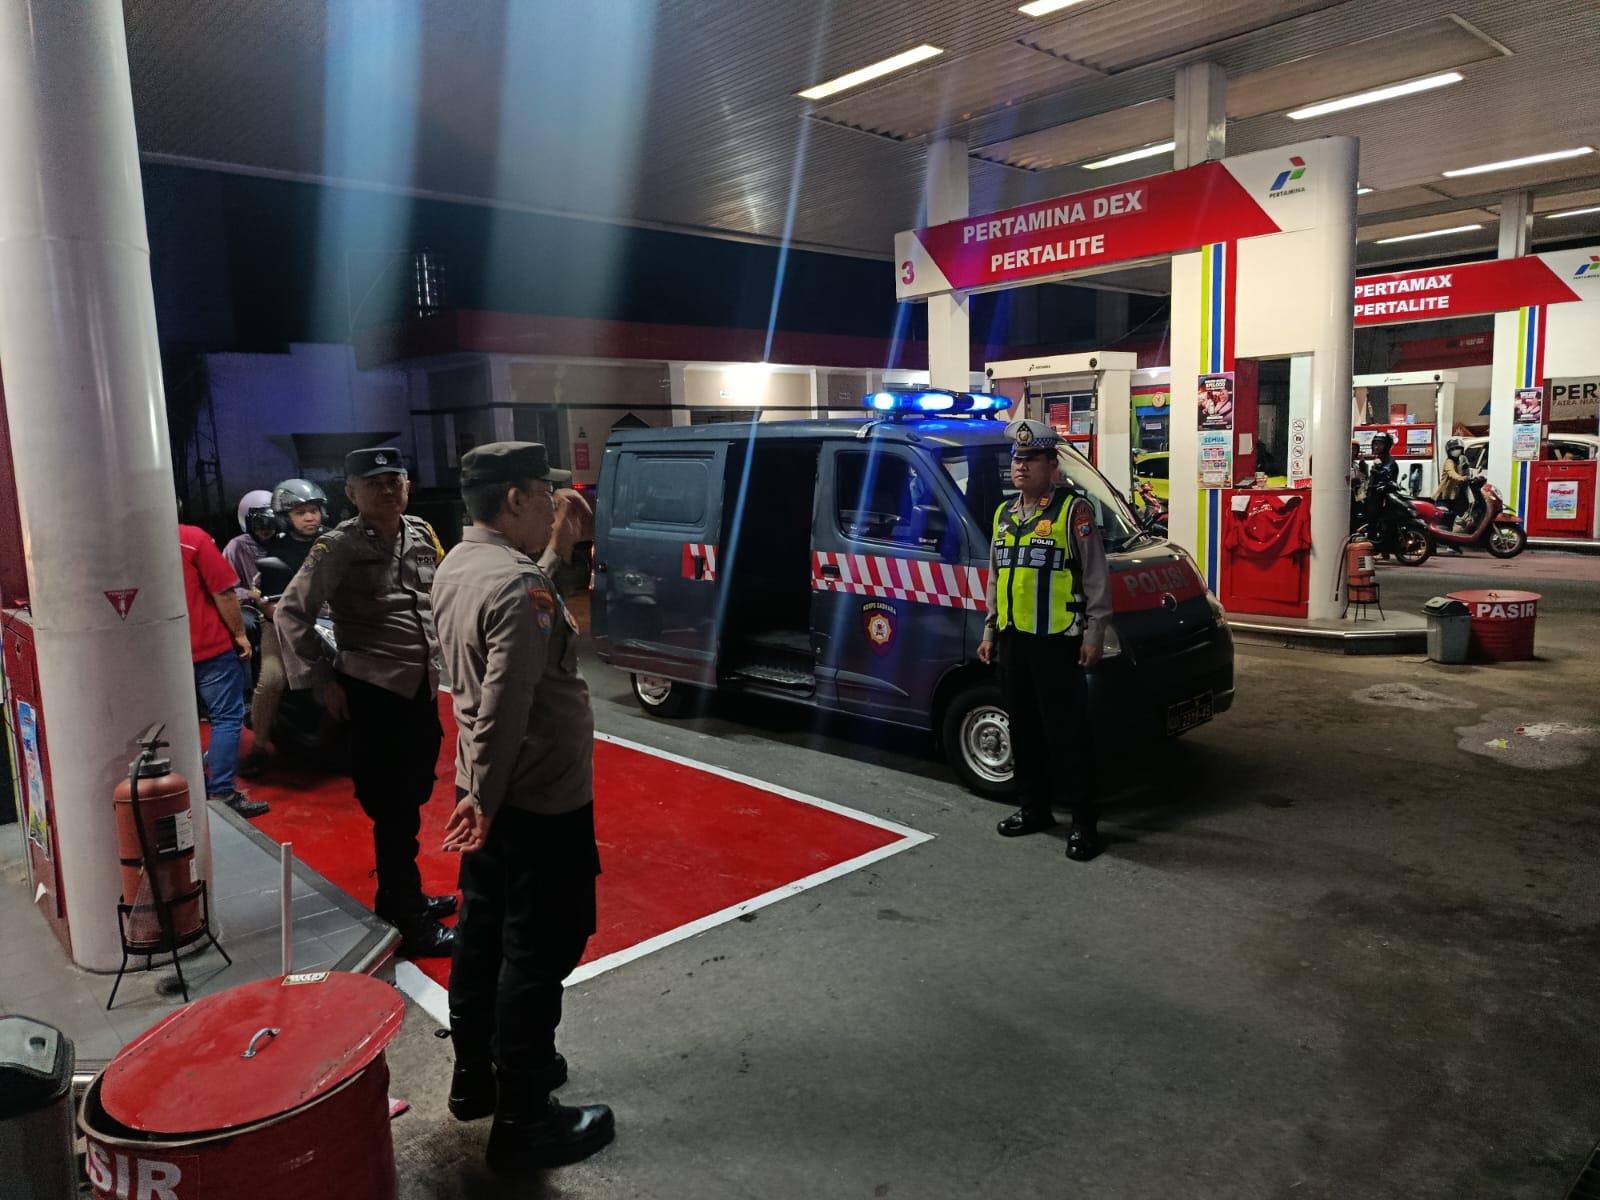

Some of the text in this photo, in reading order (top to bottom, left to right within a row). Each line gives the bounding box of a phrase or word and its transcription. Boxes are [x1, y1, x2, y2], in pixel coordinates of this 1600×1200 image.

[962, 189, 1143, 245] PERTAMINA DEX
[990, 234, 1105, 273] PERTALITE
[901, 260, 915, 285] 3
[1354, 273, 1453, 299] PERTAMAX
[1353, 295, 1450, 318] PERTALITE
[1553, 383, 1600, 400] PER
[1476, 603, 1535, 618] PASIR
[86, 1141, 182, 1200] SIR
